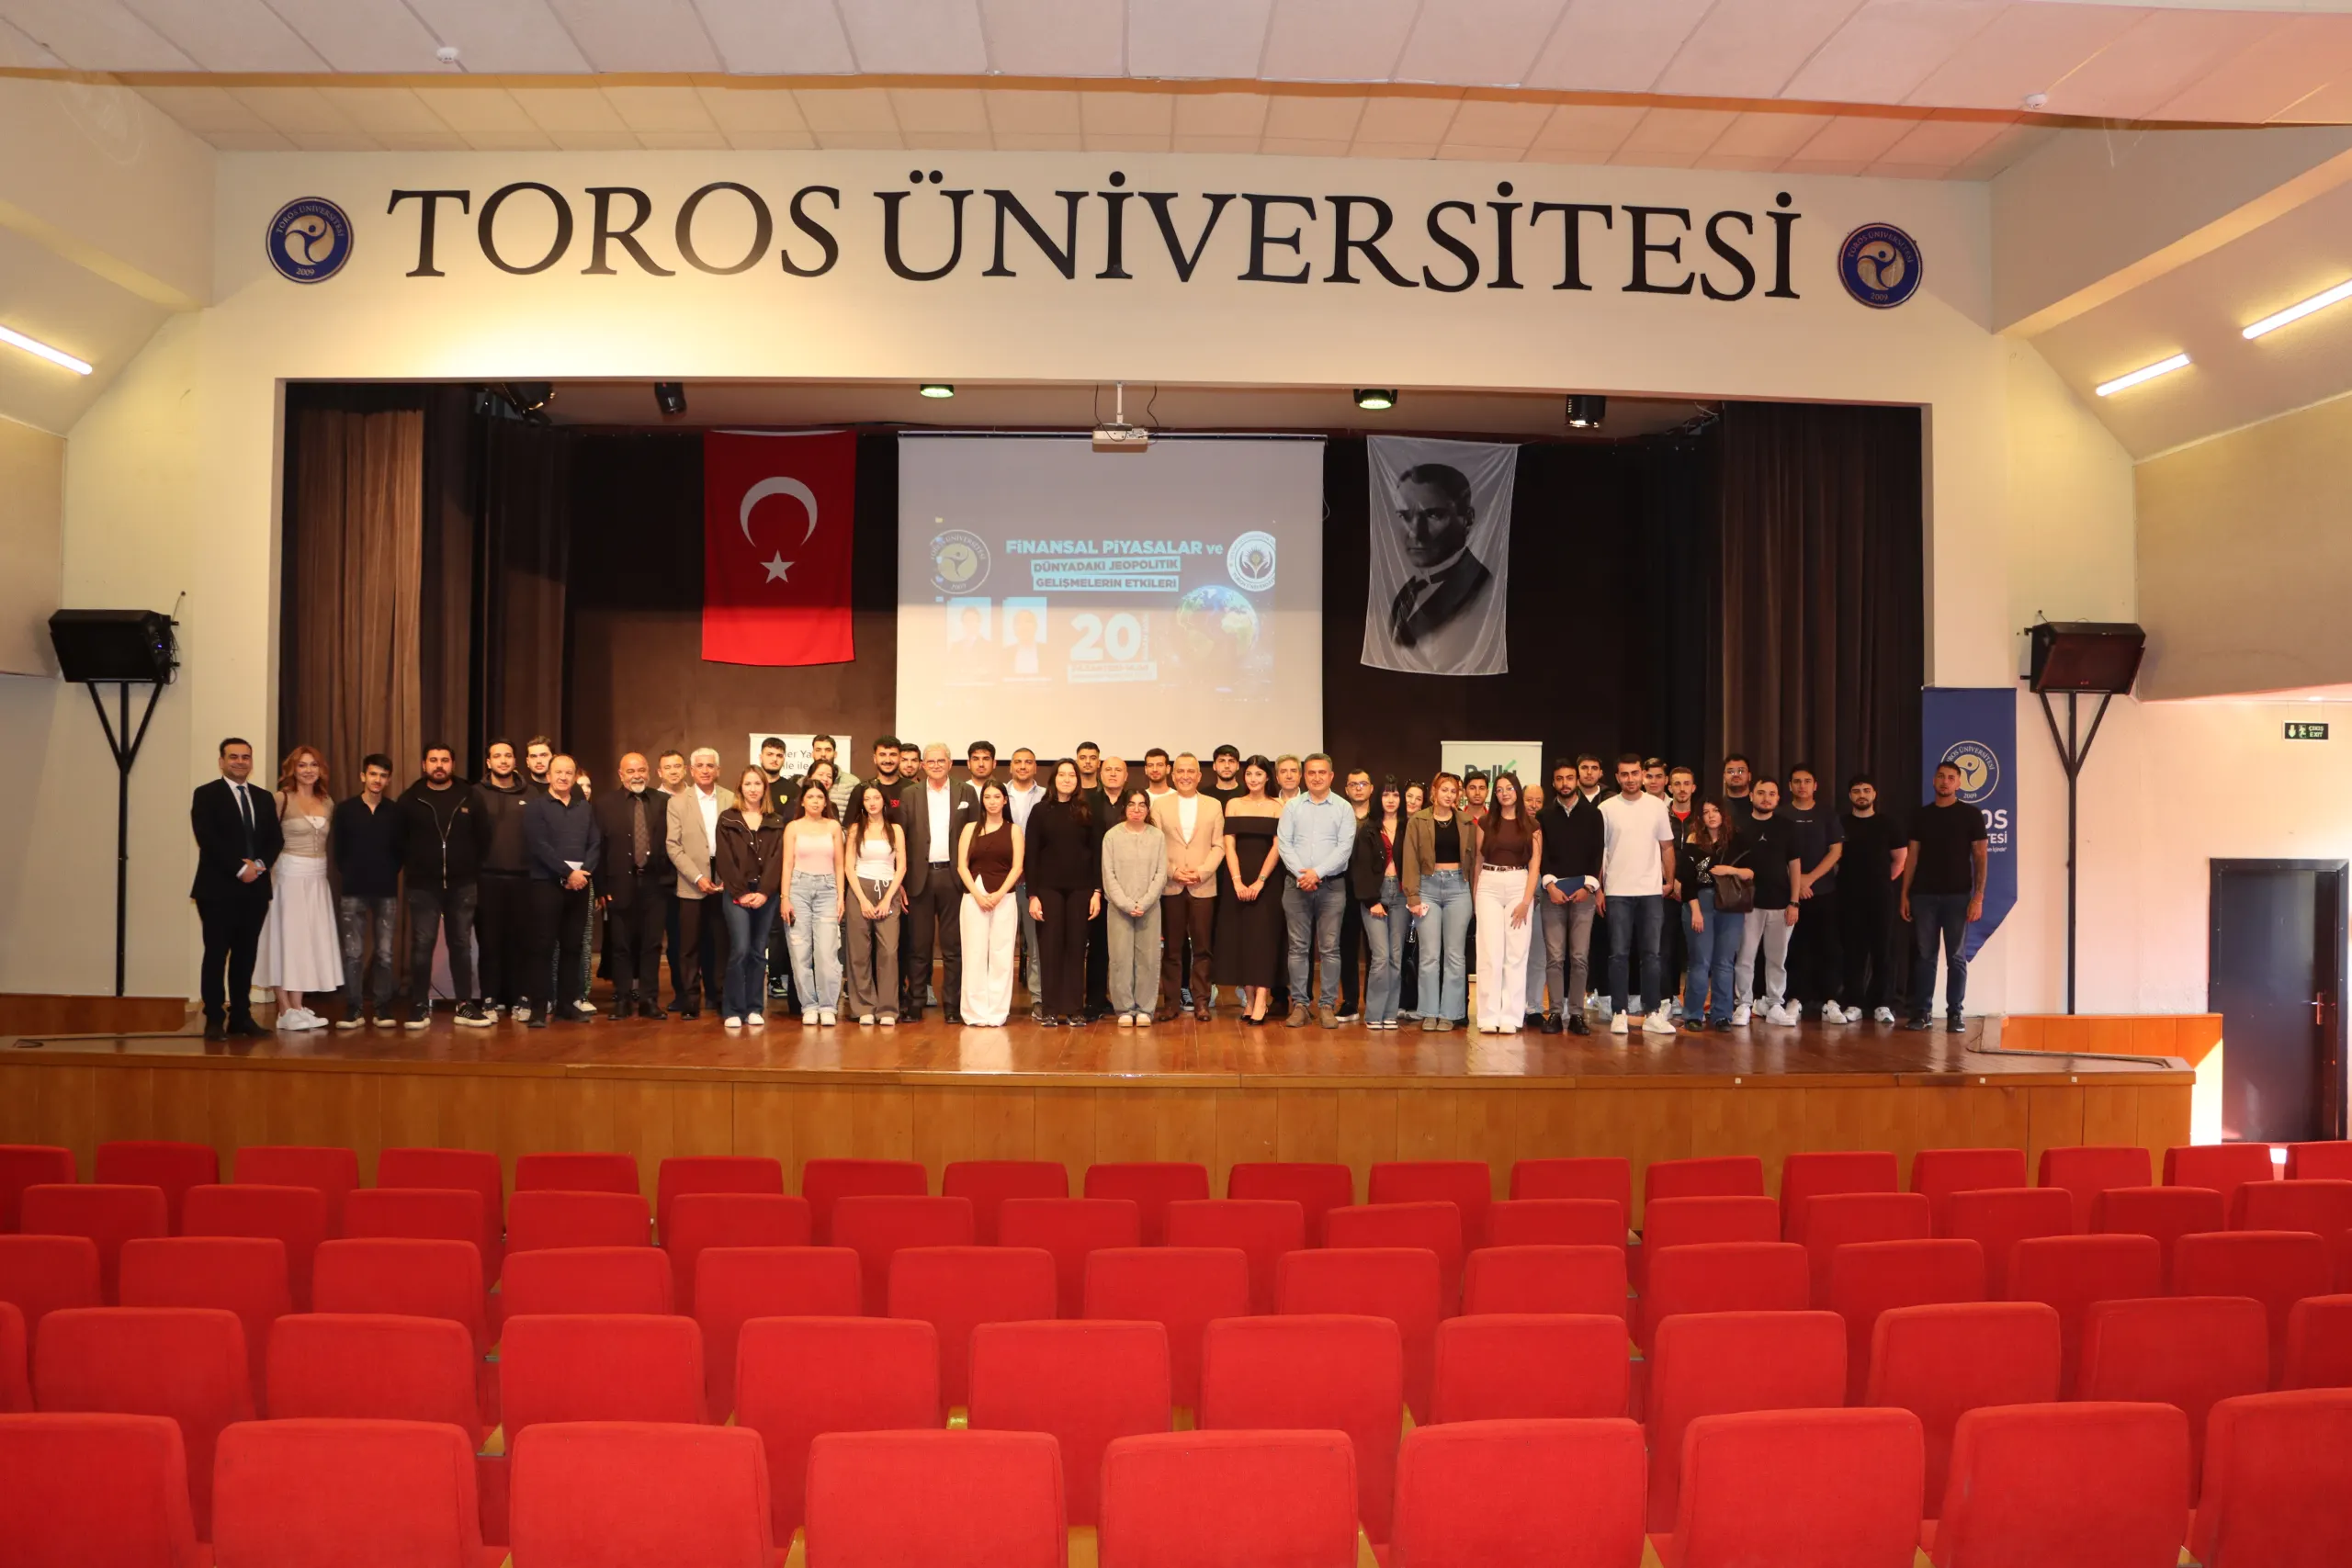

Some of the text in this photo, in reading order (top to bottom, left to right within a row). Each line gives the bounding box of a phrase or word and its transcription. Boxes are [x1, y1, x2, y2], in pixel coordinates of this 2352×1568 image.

[276, 209, 299, 234] TOROS
[387, 171, 1802, 300] TOROS ÜNİVERSİTESİ
[1848, 233, 1869, 258] TOROS
[296, 267, 315, 276] 2009
[1870, 292, 1889, 301] 2009
[1206, 543, 1224, 556] ve
[1070, 613, 1142, 660] 20
